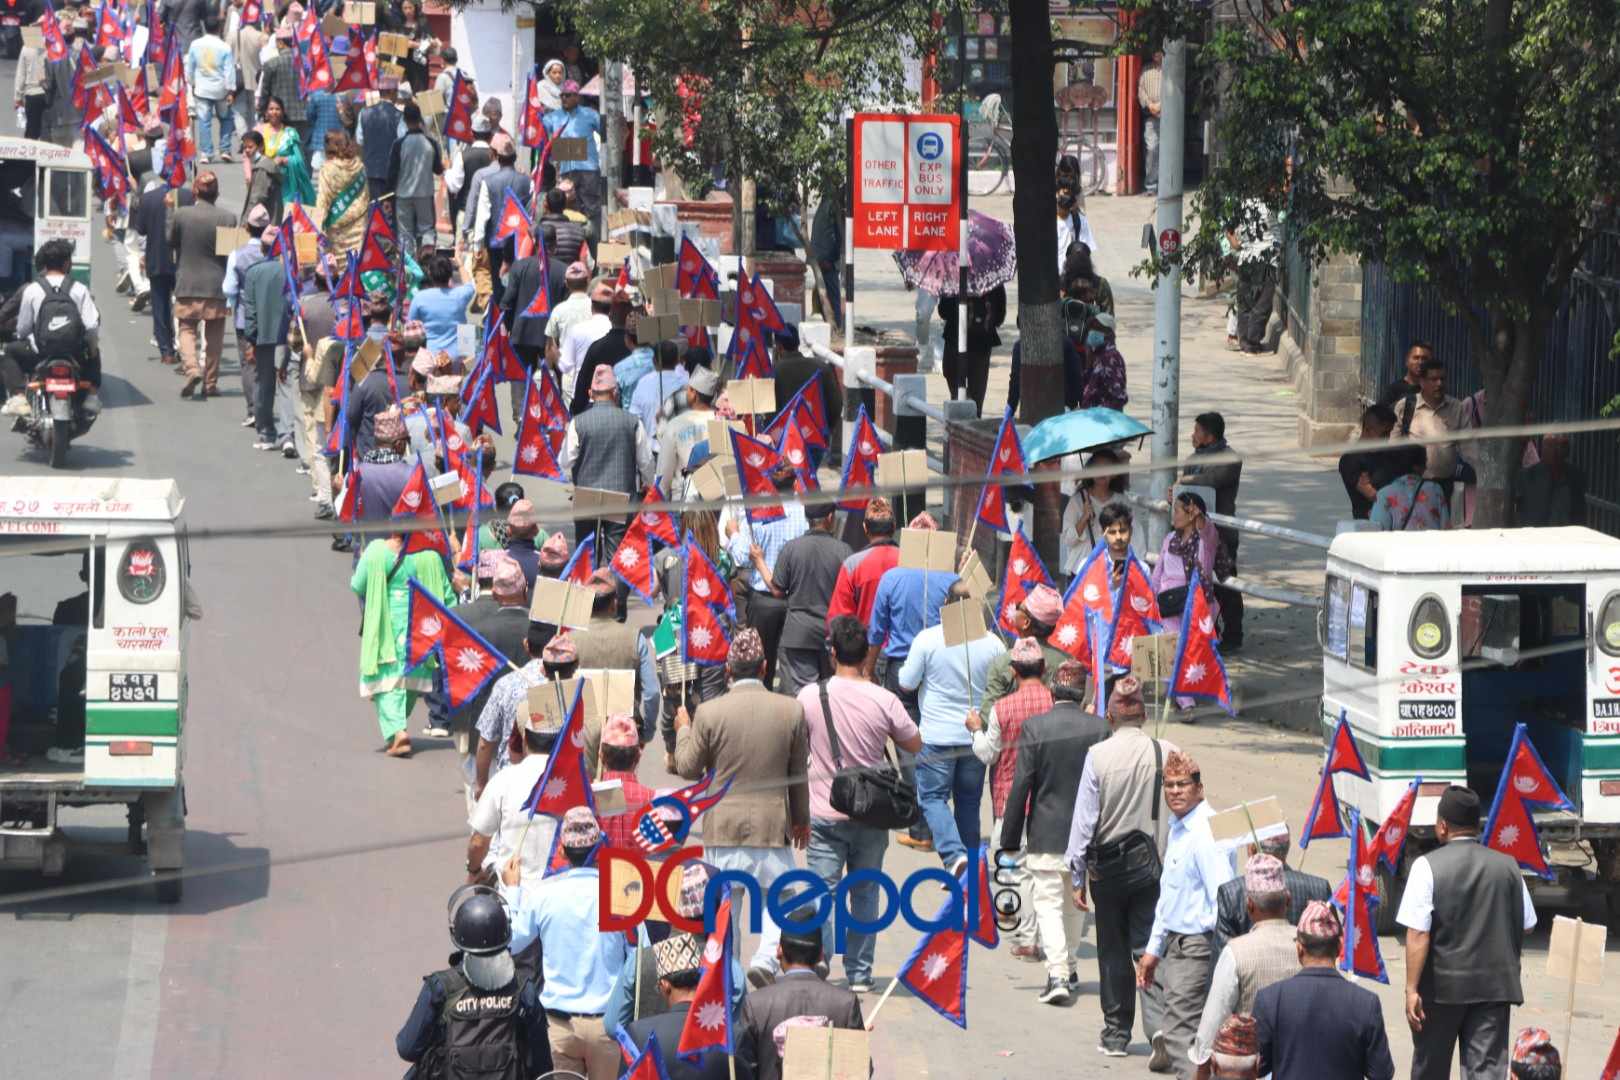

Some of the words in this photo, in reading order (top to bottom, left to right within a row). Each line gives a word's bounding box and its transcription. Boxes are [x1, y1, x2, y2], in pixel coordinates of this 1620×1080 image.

[865, 160, 896, 169] OTHER
[919, 163, 942, 172] EXP
[919, 174, 943, 183] BUS
[864, 179, 903, 189] TRAFFIC
[914, 186, 944, 196] ONLY
[868, 211, 898, 222] LEFT
[913, 211, 948, 223] RIGHT
[867, 226, 899, 237] LANE
[914, 226, 946, 237] LANE
[456, 997, 478, 1012] CITY
[479, 996, 512, 1009] POLICE
